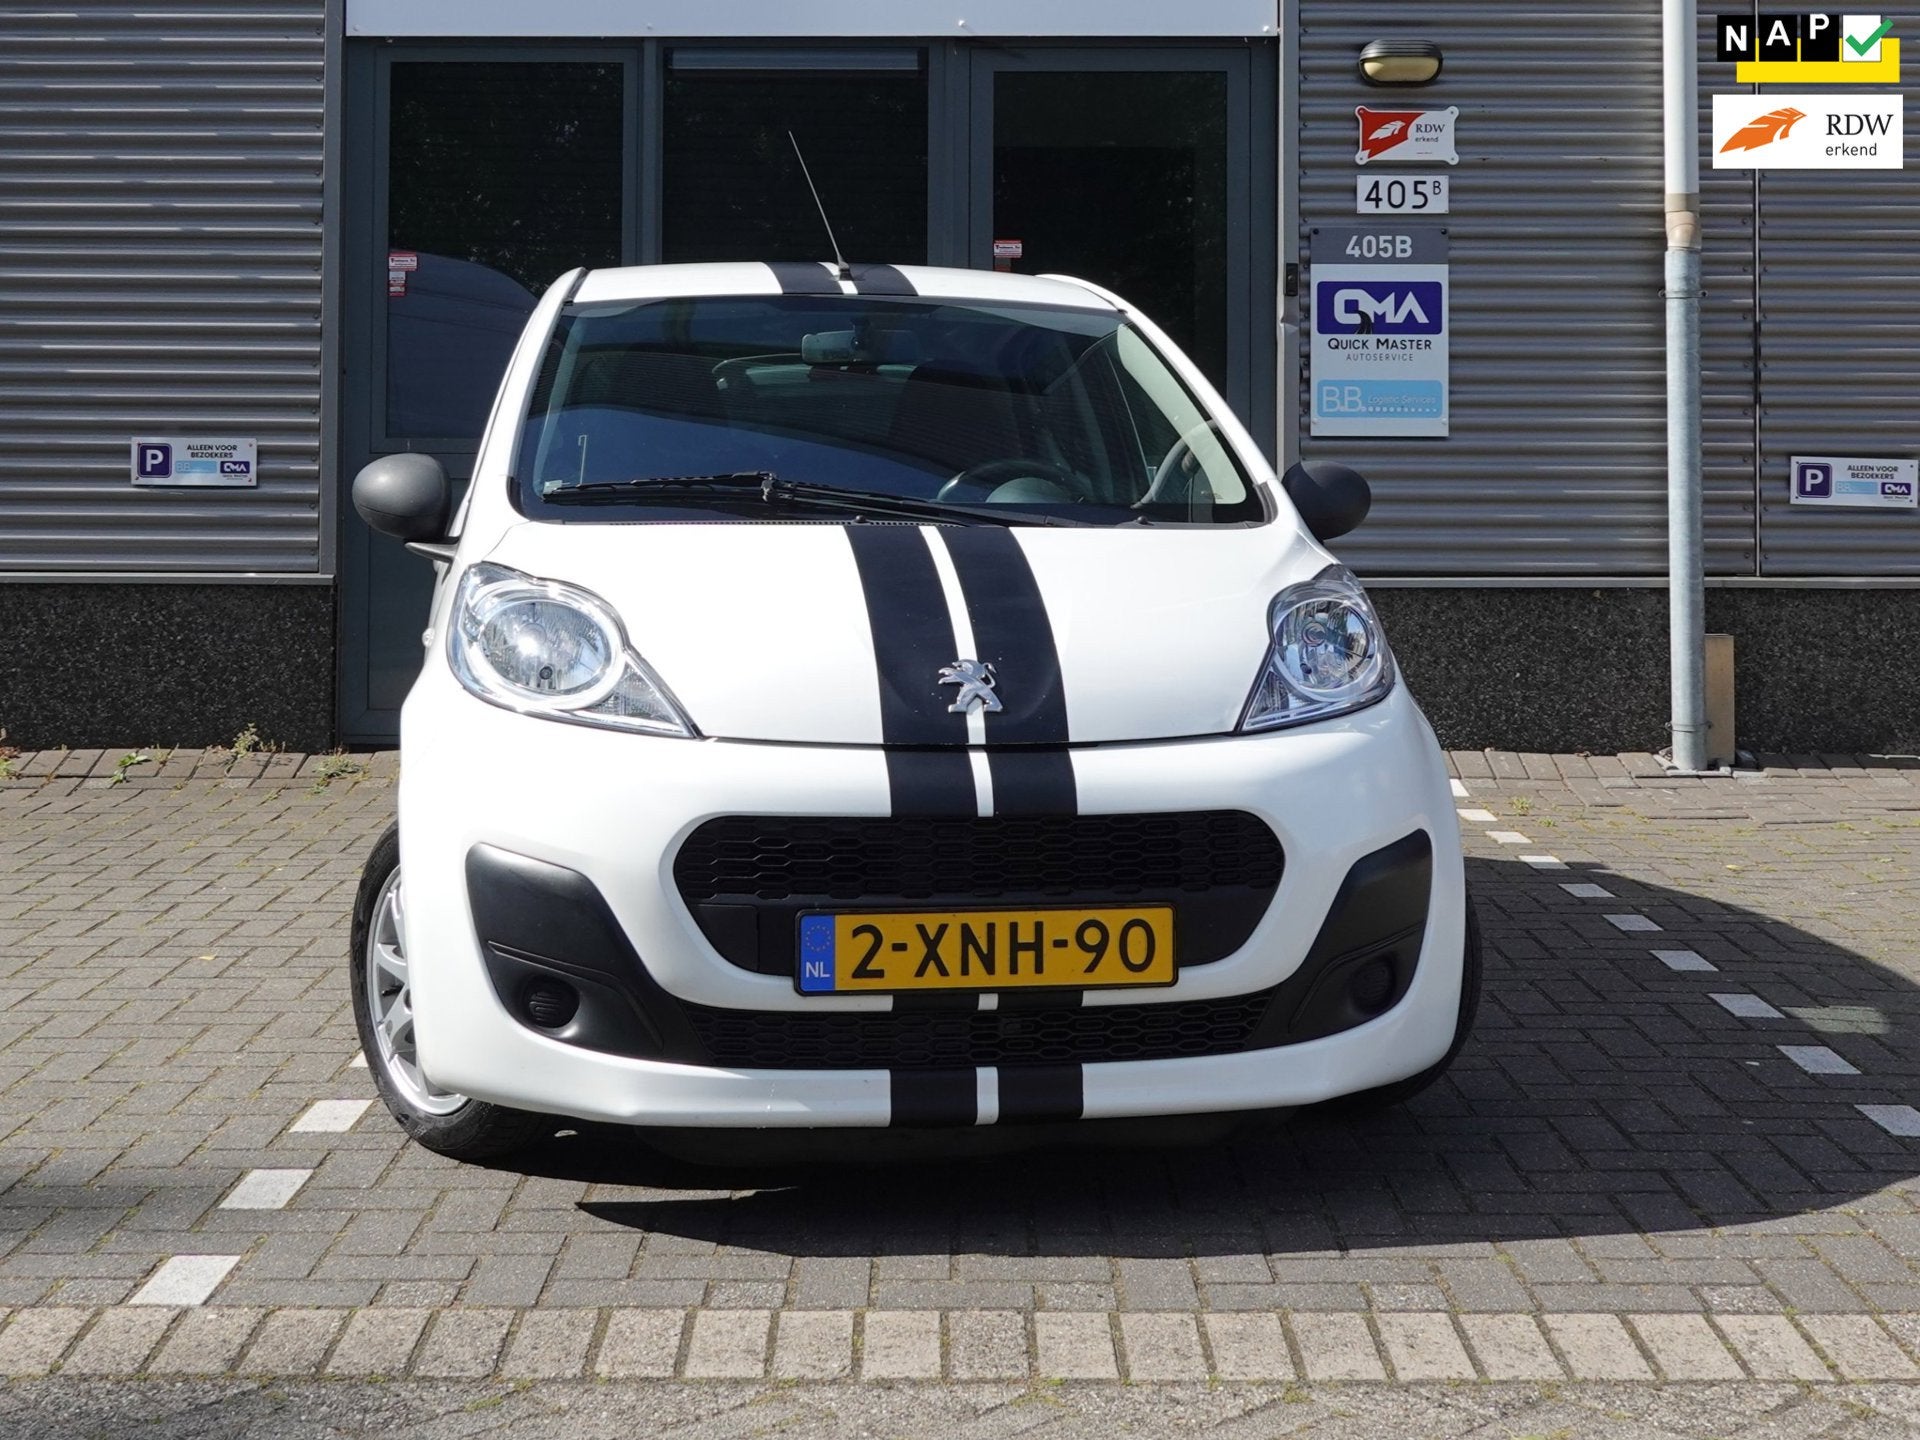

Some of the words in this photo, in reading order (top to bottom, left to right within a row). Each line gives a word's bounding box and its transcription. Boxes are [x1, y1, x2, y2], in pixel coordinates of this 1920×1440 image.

[1415, 123, 1446, 133] RDW
[1345, 235, 1413, 258] 405B
[1345, 353, 1414, 361] AUTOSERVICE
[145, 449, 164, 472] P
[1805, 468, 1824, 492] P
[1850, 472, 1895, 480] BEZOEKERS
[851, 918, 1156, 979] 2-XNH-90
[805, 962, 831, 978] NL
